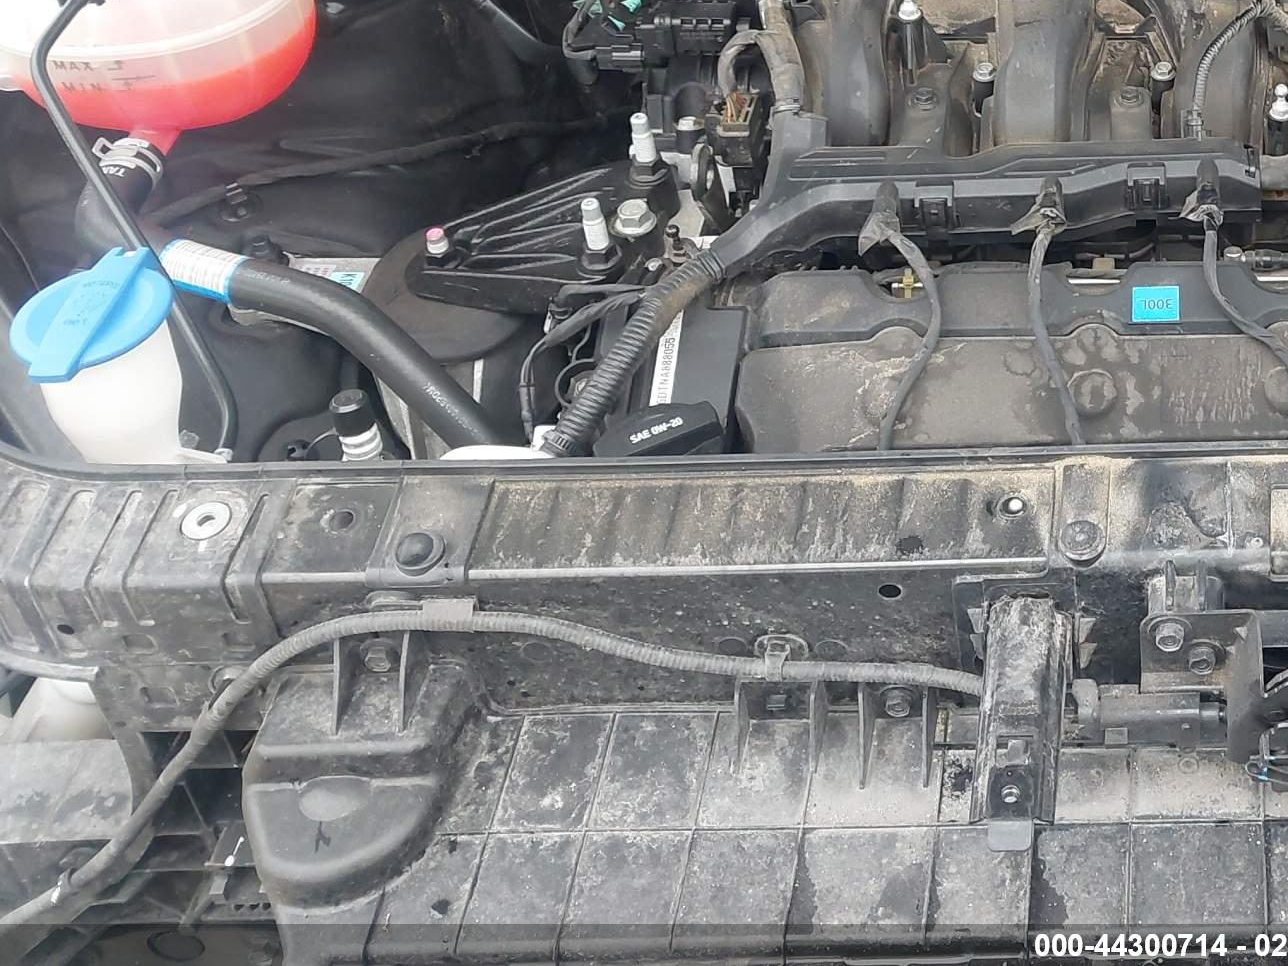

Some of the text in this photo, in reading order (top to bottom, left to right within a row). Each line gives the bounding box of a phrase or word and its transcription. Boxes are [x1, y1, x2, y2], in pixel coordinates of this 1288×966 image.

[52, 60, 93, 72] MAX
[61, 81, 104, 92] MIN
[629, 416, 684, 444] SAE 0W-20
